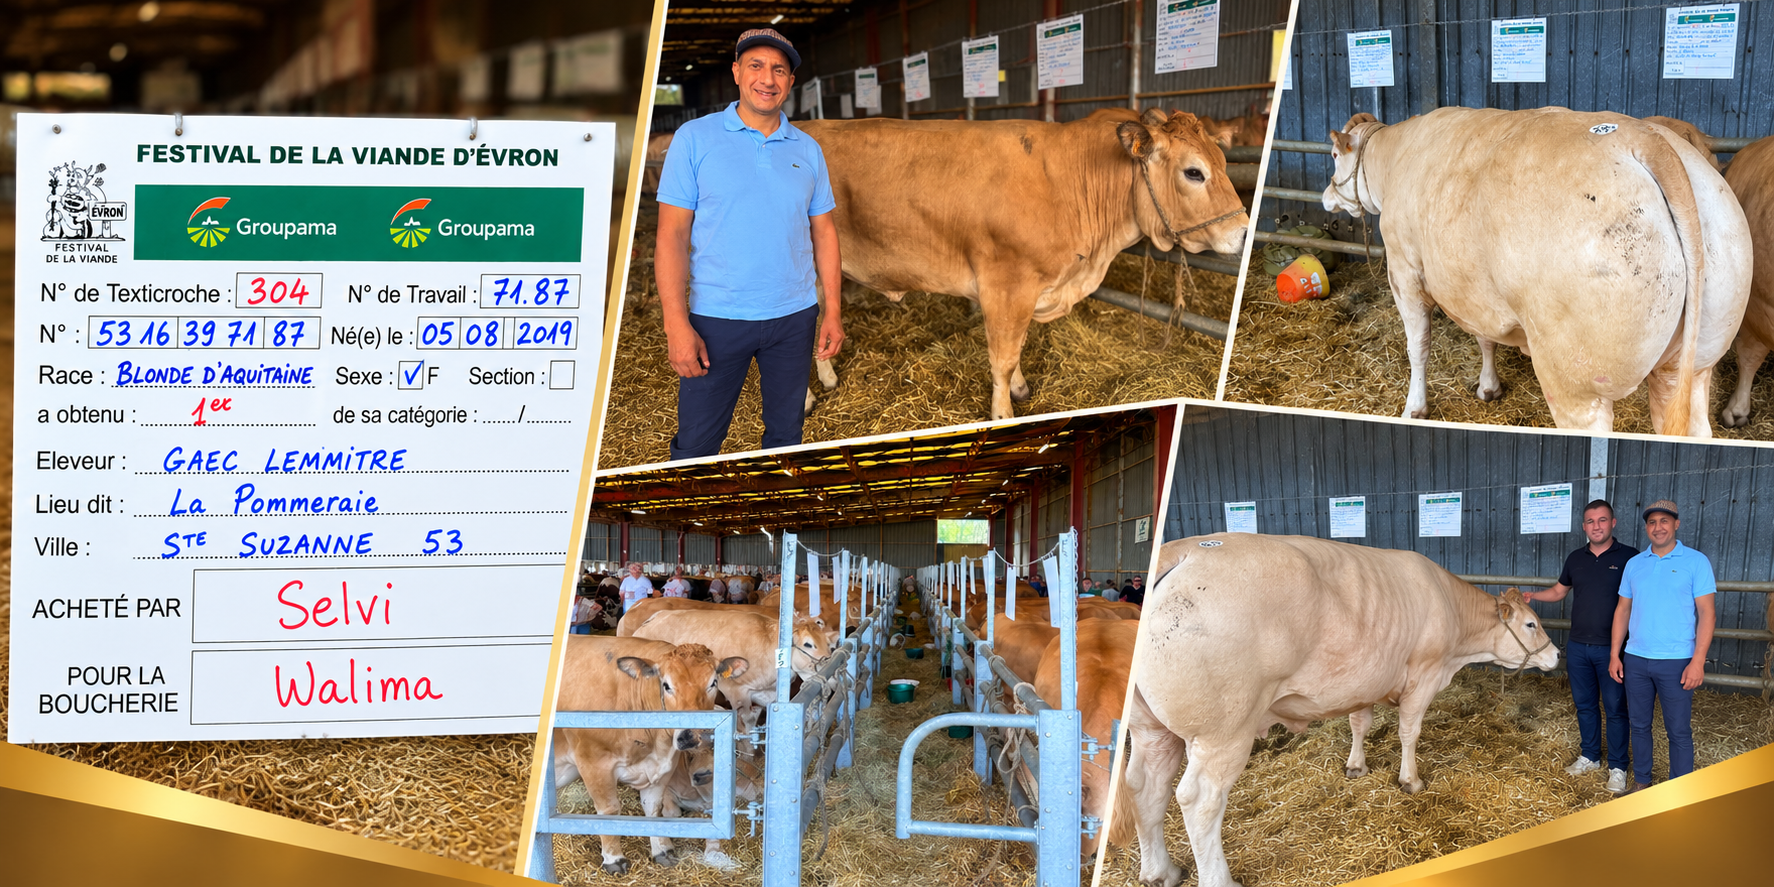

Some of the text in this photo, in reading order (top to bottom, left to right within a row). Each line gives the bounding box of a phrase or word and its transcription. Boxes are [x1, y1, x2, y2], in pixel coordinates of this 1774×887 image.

[137, 143, 559, 167] FESTIVAL DE LA VIANDE D'ÉVRON
[91, 204, 124, 218] ÉVRON
[236, 217, 337, 240] Groupama
[438, 218, 535, 241] Groupama
[45, 254, 118, 264] DE LA VIANDE
[55, 243, 109, 253] FESTIVAL
[41, 282, 67, 302] N°
[74, 283, 100, 303] de
[106, 283, 221, 303] Texticroche
[247, 276, 310, 306] 304
[348, 284, 372, 304] N°
[377, 284, 401, 304] de
[406, 284, 467, 304] Travail
[493, 277, 570, 306] 71.87
[40, 323, 66, 344] N°
[96, 319, 305, 348] 53 16 39 71 87
[331, 326, 381, 350] Né(e)
[387, 326, 403, 346] le
[421, 320, 573, 348] 05 08 2019
[39, 364, 93, 385] Race
[115, 360, 195, 387] BLONDE
[335, 366, 383, 386] Sexe
[427, 366, 440, 385] F
[468, 366, 535, 385] Section
[37, 408, 50, 424] a
[56, 404, 124, 424] obtenu
[333, 405, 356, 424] de
[361, 409, 382, 424] sa
[387, 405, 468, 428] catégorie
[36, 450, 116, 471] Eleveur
[162, 446, 238, 474] GAEC
[35, 494, 78, 514] Lieu
[87, 494, 113, 514] dit
[169, 482, 379, 517] La Pommeraie
[34, 536, 79, 557] Ville
[238, 531, 374, 559] SUZANNE
[421, 528, 464, 556] 53
[31, 593, 181, 619] ACHETÉ PAR
[277, 579, 393, 630] Selvi
[67, 665, 166, 686] POUR LA
[274, 658, 444, 708] Walima
[39, 692, 179, 715] BOUCHERIE
